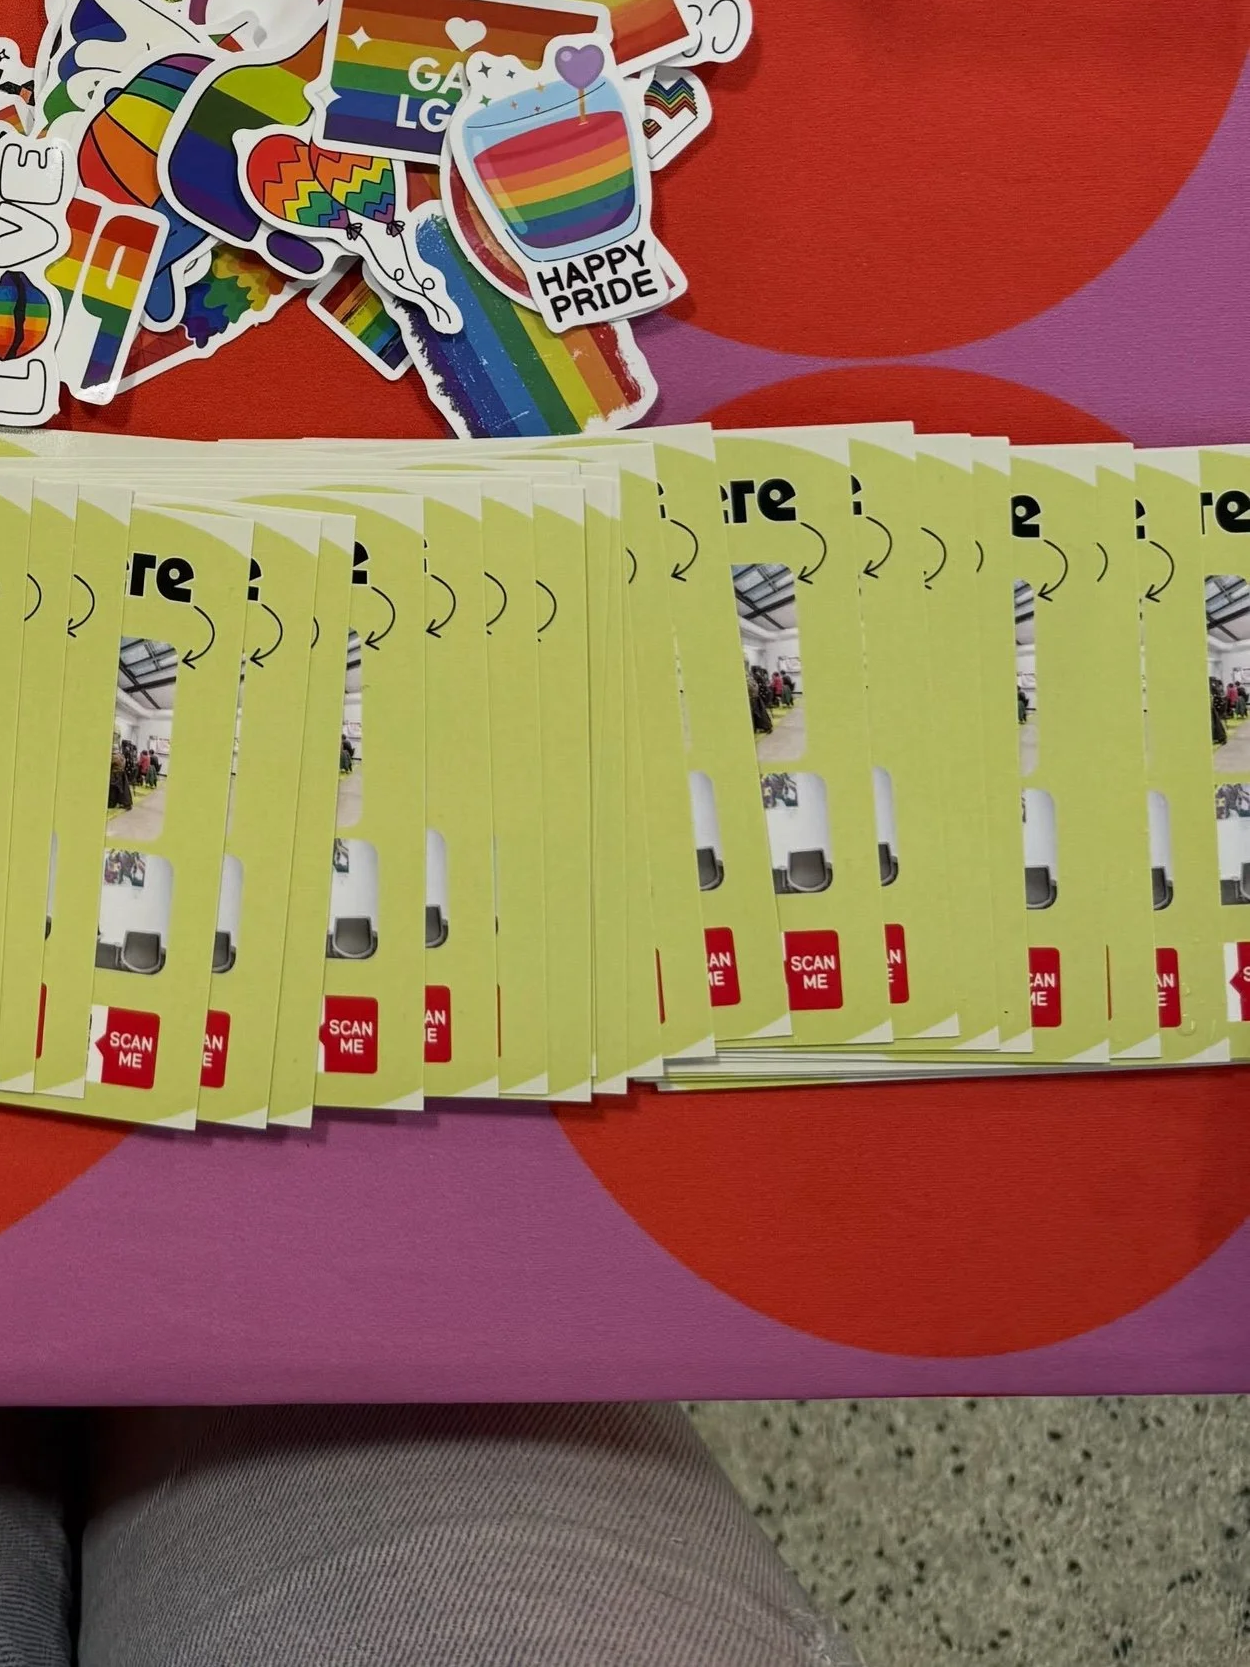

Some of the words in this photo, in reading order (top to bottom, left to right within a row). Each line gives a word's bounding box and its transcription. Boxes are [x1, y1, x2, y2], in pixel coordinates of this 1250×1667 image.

[536, 239, 646, 296] HAPPY
[549, 268, 659, 324] PRIDE
[790, 954, 836, 972] SCAN
[803, 974, 829, 990] ME
[329, 1019, 373, 1037] SCAN
[109, 1031, 154, 1053] SCAN
[340, 1037, 364, 1055] ME
[118, 1050, 143, 1069] ME
